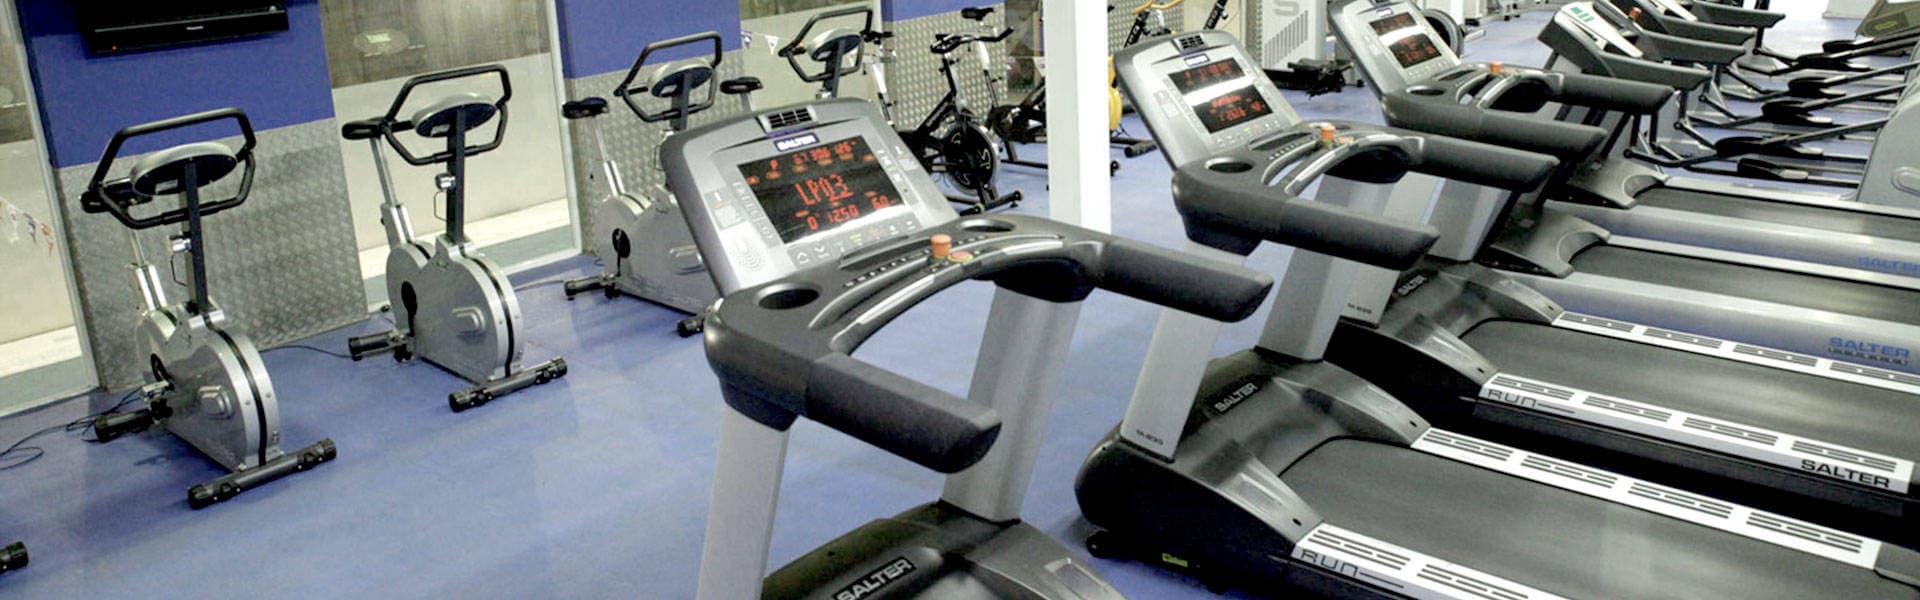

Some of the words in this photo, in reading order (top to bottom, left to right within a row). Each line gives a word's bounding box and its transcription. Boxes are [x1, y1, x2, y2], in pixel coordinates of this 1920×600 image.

[827, 204, 860, 224] 1250
[1828, 336, 1909, 358] SALTER
[1214, 382, 1258, 412] SALTER
[1800, 458, 1890, 489] SALTER
[836, 559, 913, 600] SALTER
